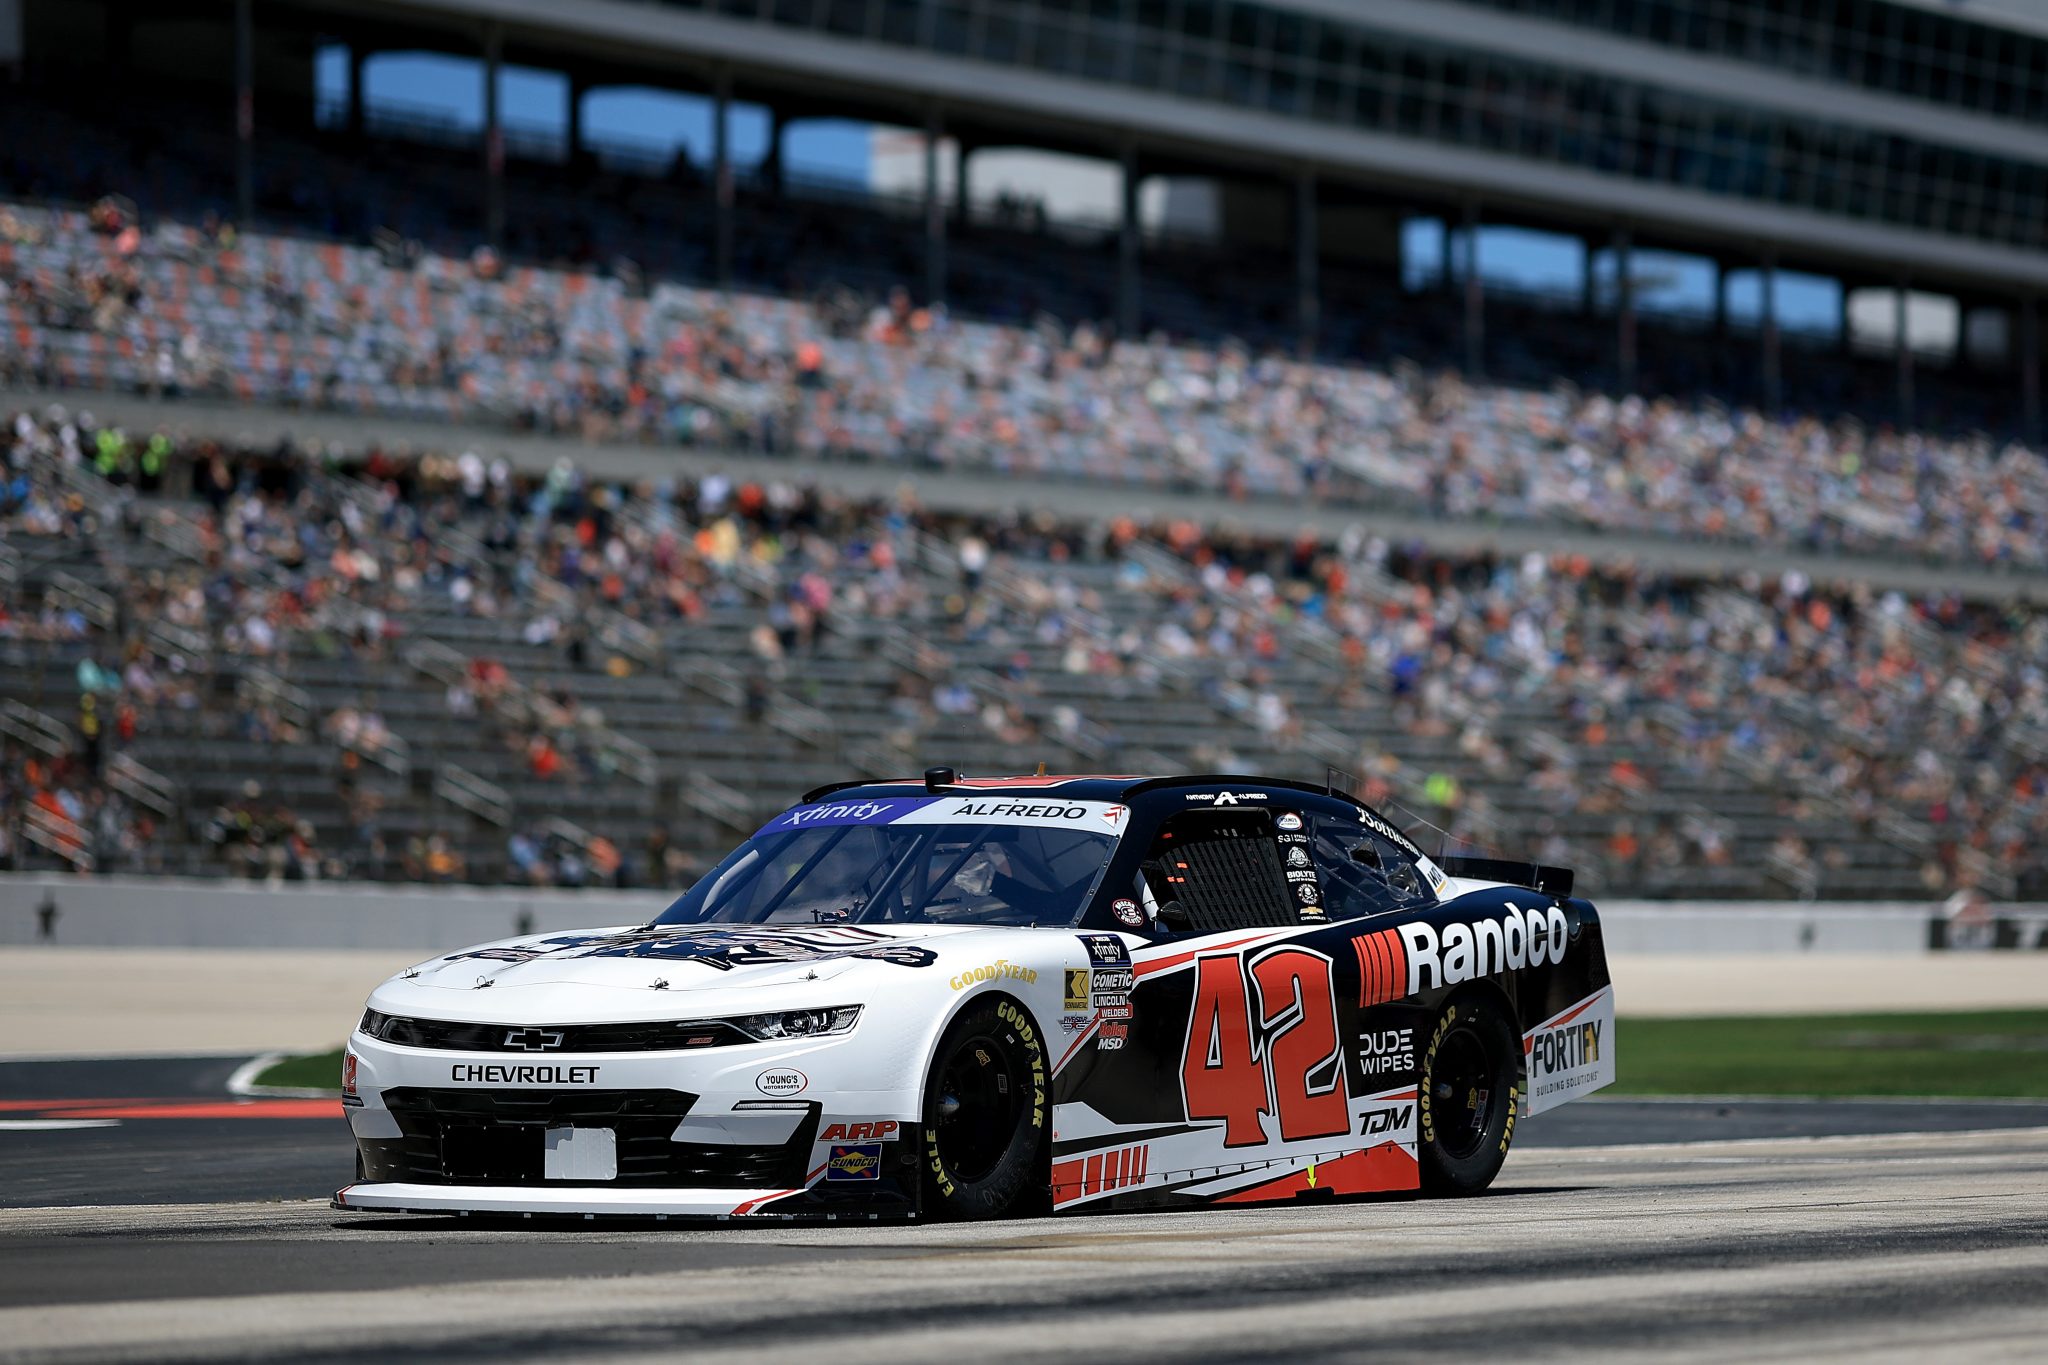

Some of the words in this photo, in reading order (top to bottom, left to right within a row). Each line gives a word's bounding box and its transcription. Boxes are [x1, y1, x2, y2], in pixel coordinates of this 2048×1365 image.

[782, 803, 894, 825] xfinity
[952, 804, 1087, 819] ALFREDO
[1286, 870, 1316, 879] BIOLYTE
[1092, 942, 1120, 959] xfinity
[1397, 902, 1568, 996] Randco
[950, 960, 1037, 991] GOODYEAR
[1093, 972, 1133, 988] COMETIC
[1094, 995, 1126, 1007] LINCOLN
[1101, 1008, 1128, 1017] WELDERS
[1098, 1038, 1123, 1050] MSD
[1180, 945, 1351, 1149] 42
[1360, 1028, 1413, 1056] DUDE
[1533, 1019, 1602, 1078] FORTIFY
[452, 1064, 600, 1084] CHEVROLET
[997, 1001, 1045, 1129] GOODYEAR
[1360, 1053, 1414, 1075] WIPES
[766, 1075, 798, 1084] YOUNG'S
[1536, 1080, 1565, 1097] BUILDING
[819, 1120, 898, 1140] ARP
[1358, 1104, 1413, 1136] TDM
[831, 1156, 877, 1168] SUNOCO
[926, 1129, 954, 1197] EAGLE
